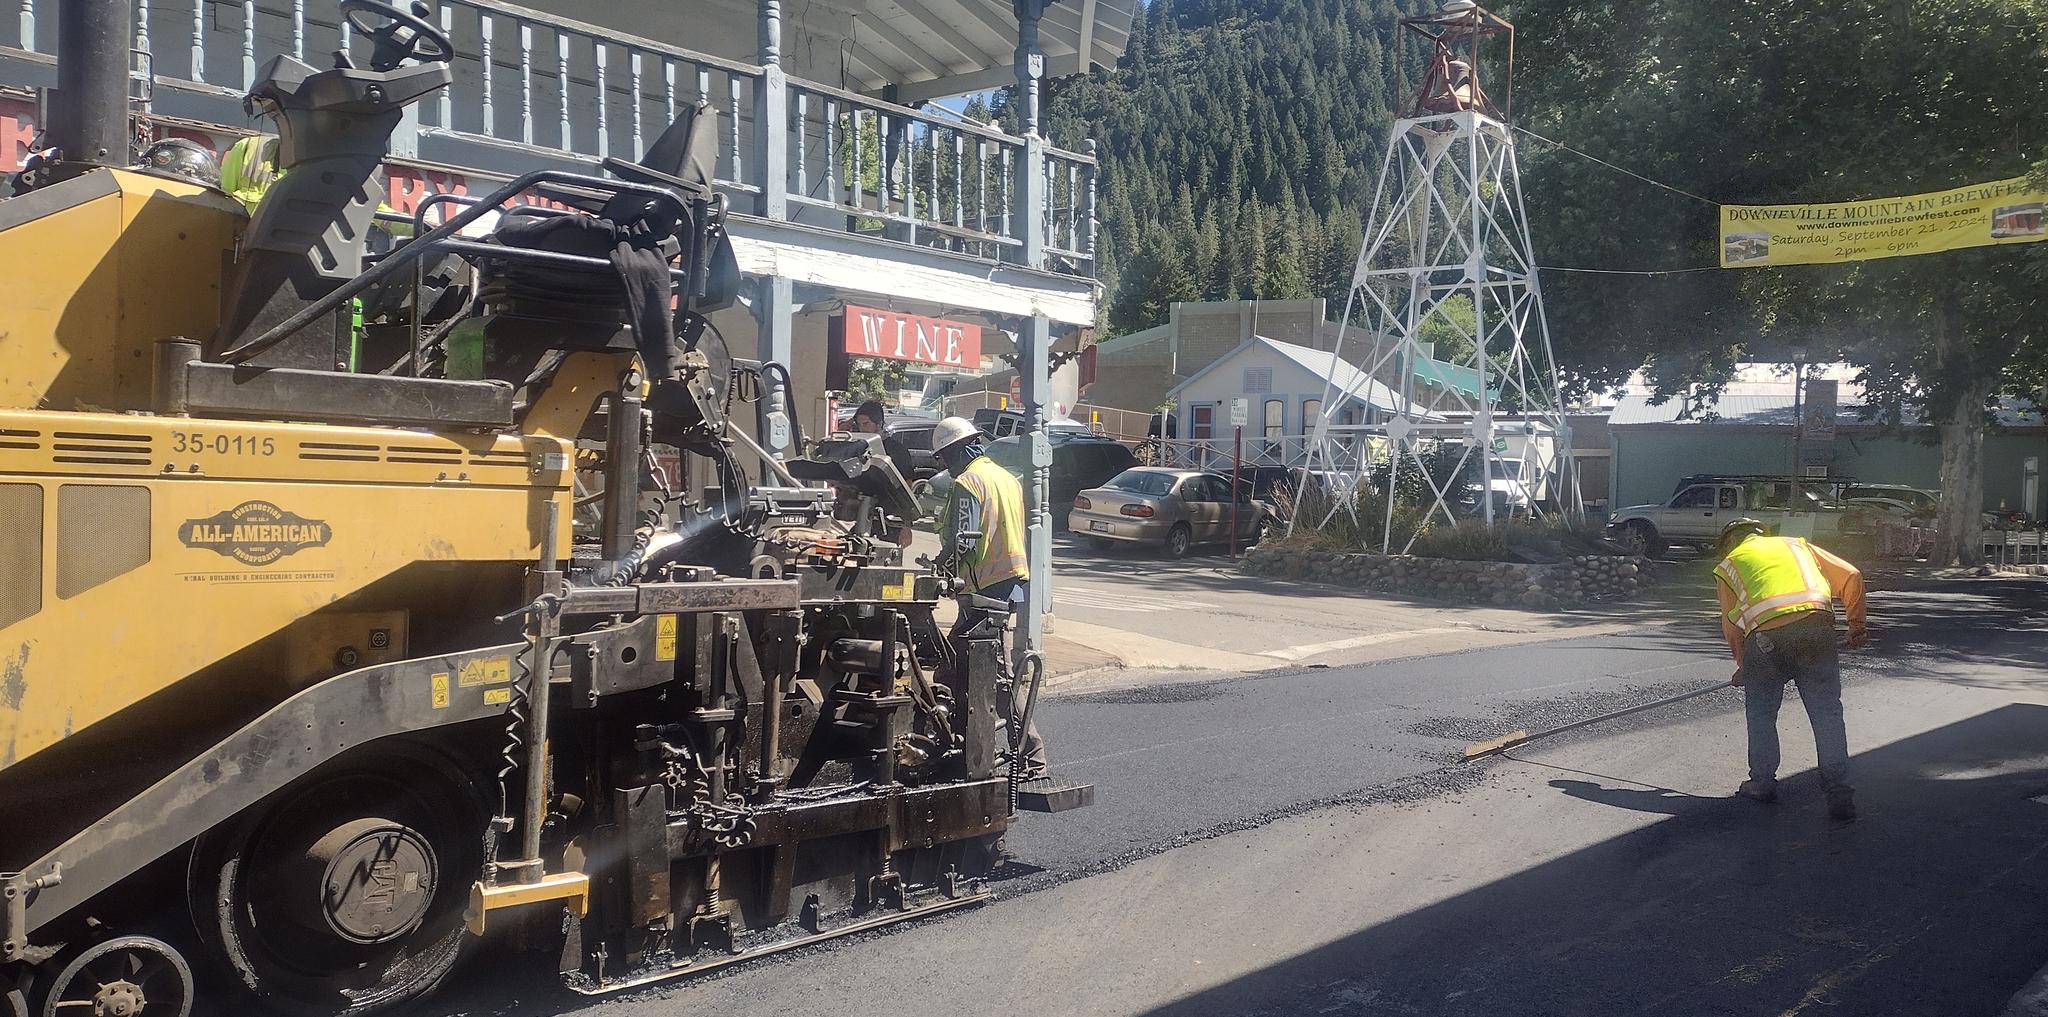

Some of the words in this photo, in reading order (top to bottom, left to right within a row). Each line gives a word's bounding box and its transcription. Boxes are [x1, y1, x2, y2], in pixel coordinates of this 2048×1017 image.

[1729, 208, 1838, 221] DOWNIEVILLE
[1843, 198, 1935, 219] MOUNTAIN
[1941, 182, 2030, 208] BREWFE
[1796, 206, 1981, 231] www.downievillebrewfest.com
[1771, 233, 1834, 246] Saturday,
[1839, 226, 1913, 244] September
[1918, 223, 1943, 235] 21,
[1948, 214, 1988, 231] 2024
[1834, 246, 1867, 257] 2pm
[1887, 241, 1919, 253] 6pm
[859, 312, 965, 365] WINE
[172, 432, 275, 456] 35-0115
[231, 503, 282, 520] CONSTRUCTION
[784, 515, 803, 523] YETI
[190, 524, 322, 543] ALL-AMERICAN
[233, 547, 282, 563] INCORPORATED
[209, 573, 240, 581] BUILDING
[251, 573, 293, 581] ENGINEERING
[295, 572, 335, 580] CONTRACTOR
